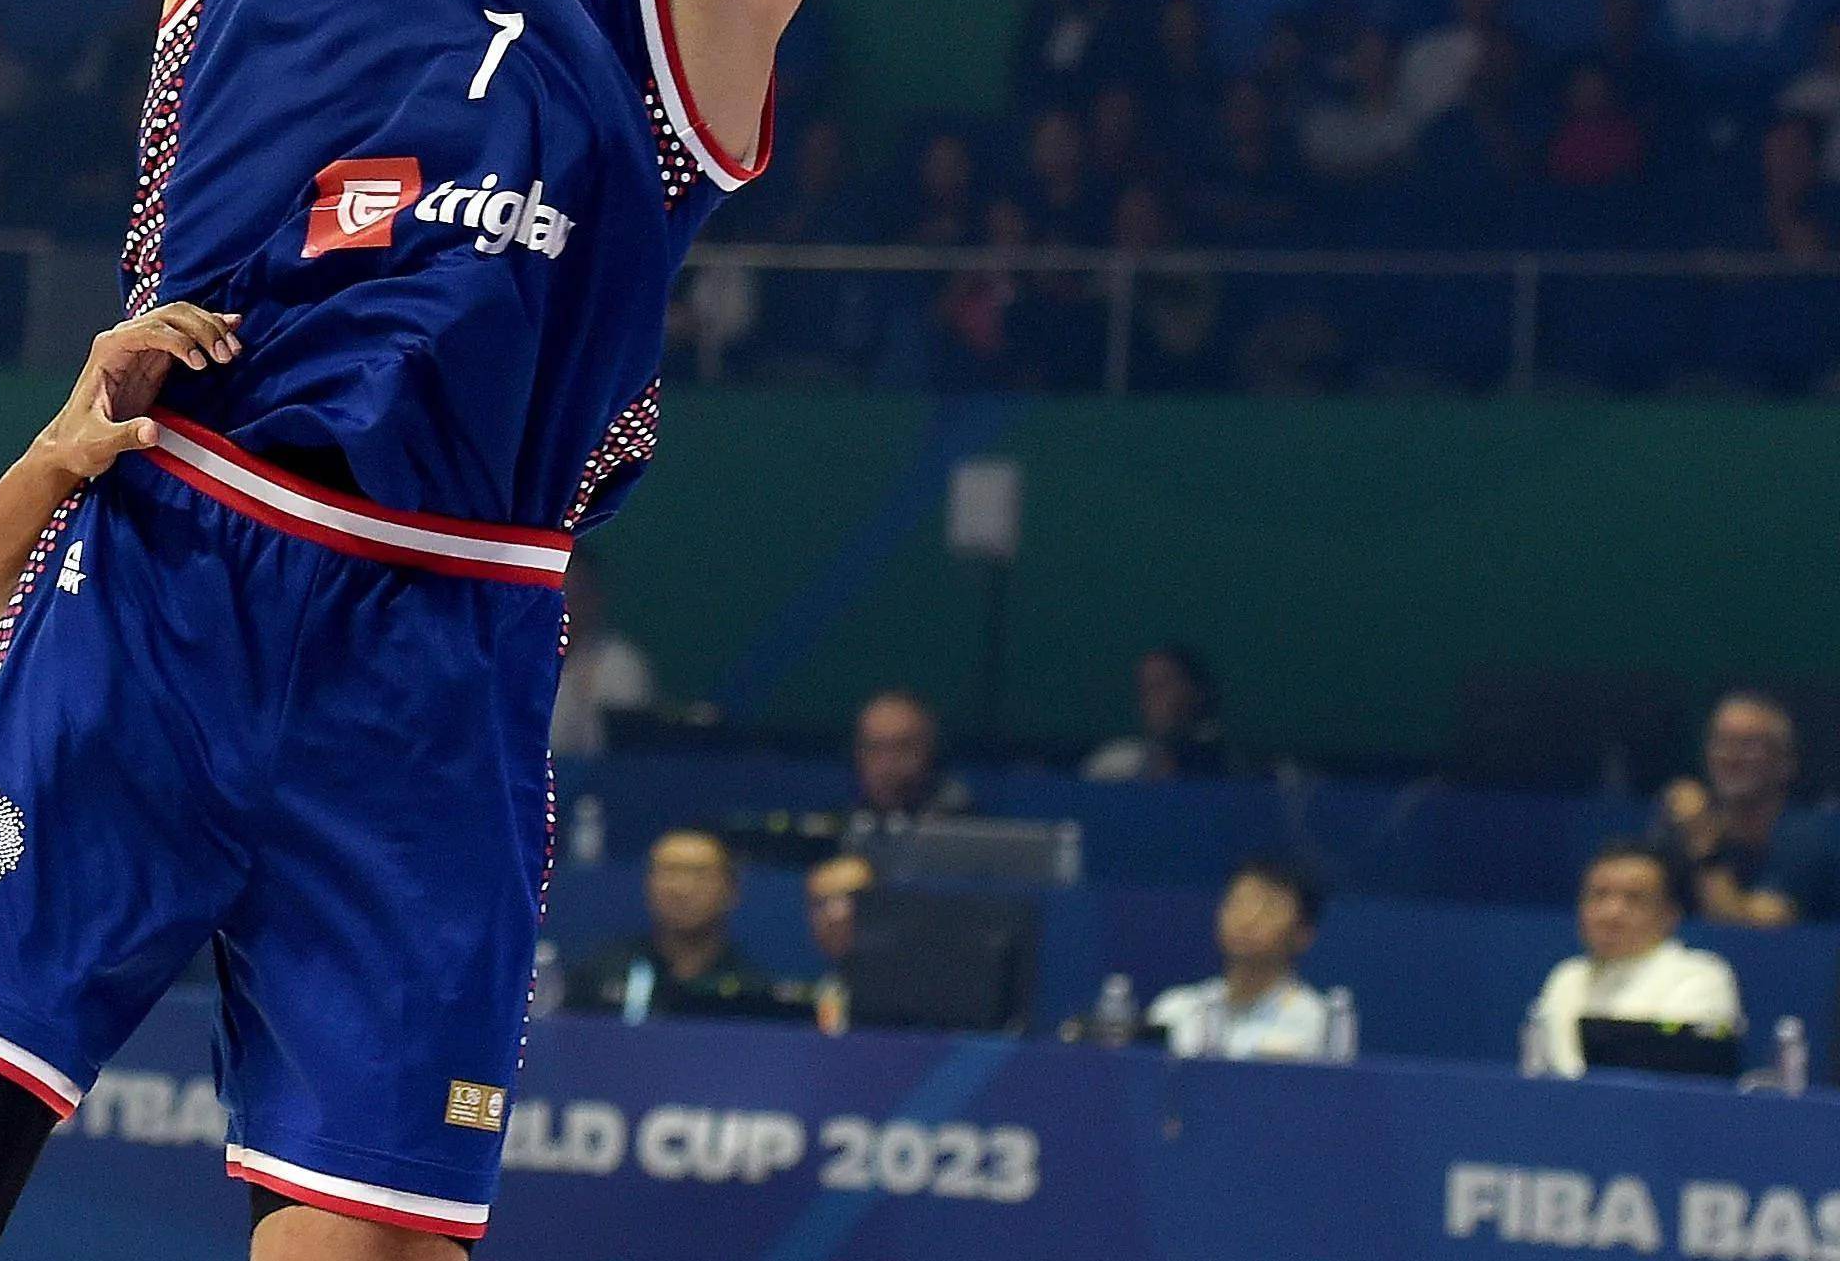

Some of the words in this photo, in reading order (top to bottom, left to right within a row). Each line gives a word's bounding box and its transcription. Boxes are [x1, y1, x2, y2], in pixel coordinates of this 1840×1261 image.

[467, 8, 525, 100] 7
[637, 1104, 808, 1183] CUP
[817, 1113, 1042, 1204] 2023
[1445, 1159, 1661, 1255] FIBA
